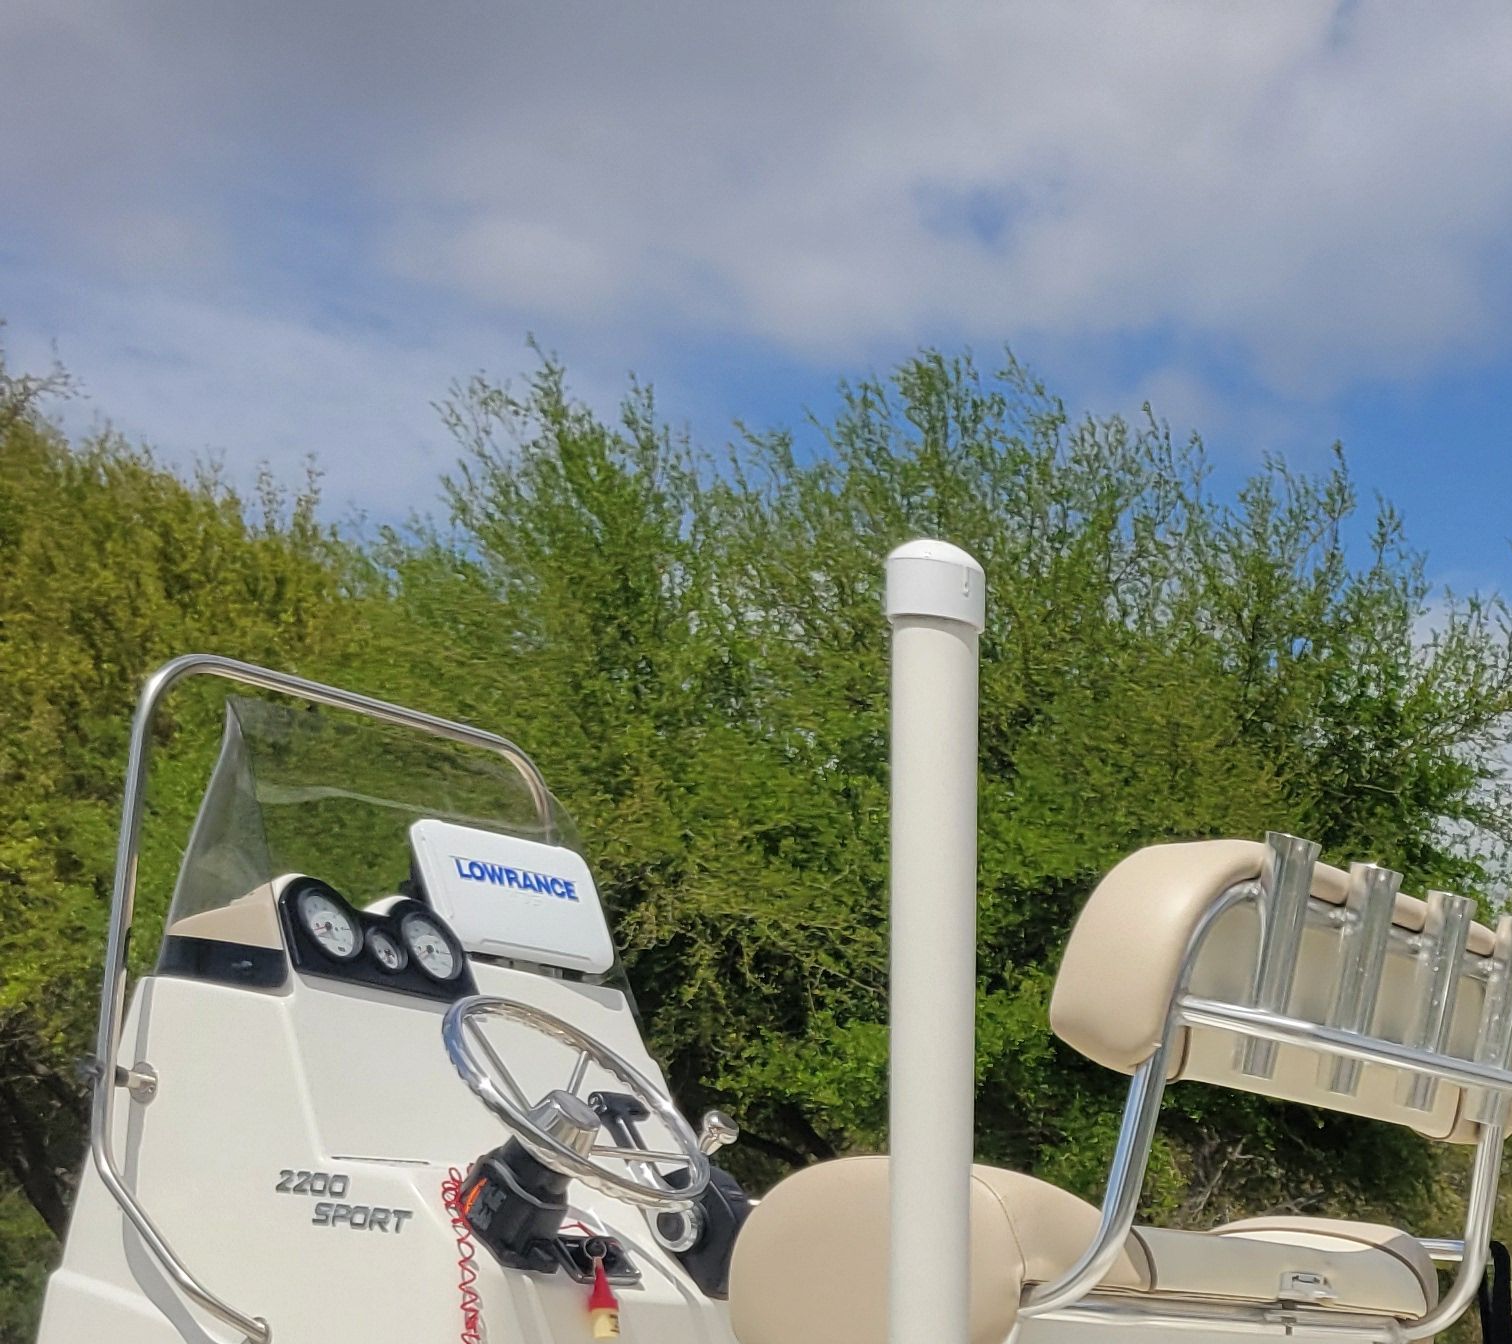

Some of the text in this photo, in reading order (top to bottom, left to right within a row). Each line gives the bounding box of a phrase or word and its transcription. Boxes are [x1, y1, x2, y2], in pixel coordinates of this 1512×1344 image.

[454, 858, 579, 902] LOWRANCE
[275, 1169, 350, 1198] 2200
[311, 1202, 413, 1234] SPORT
